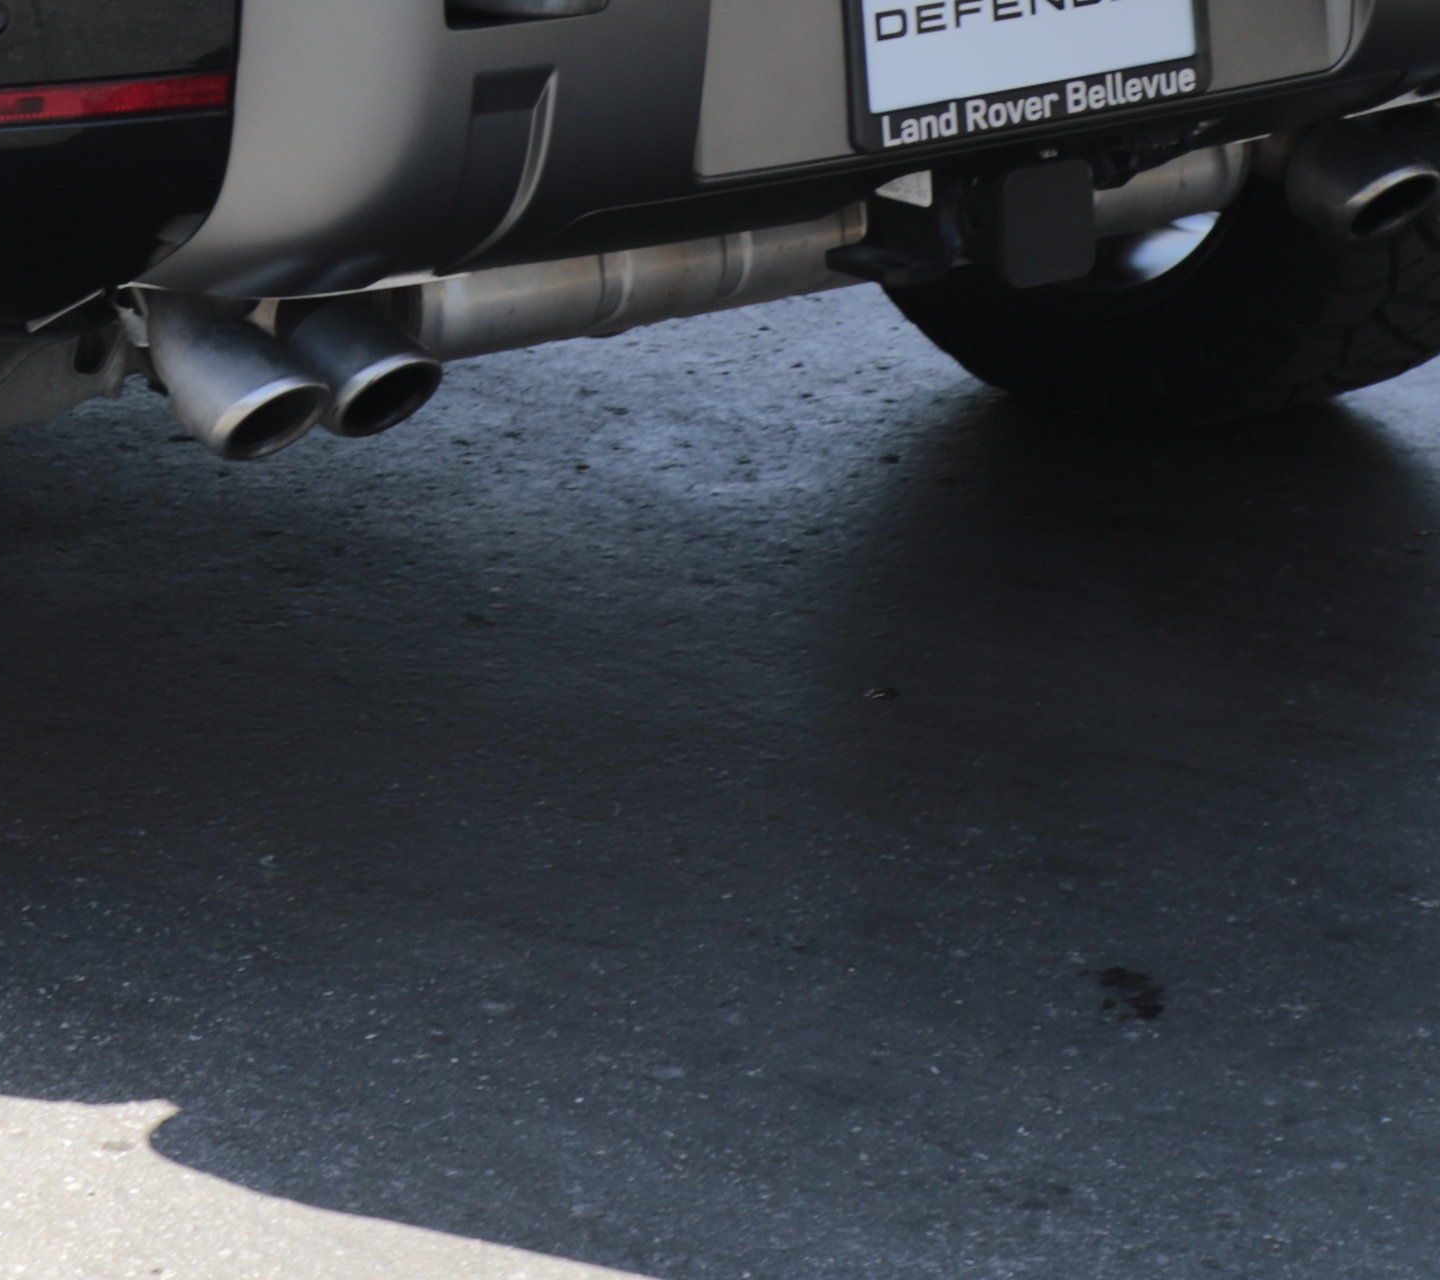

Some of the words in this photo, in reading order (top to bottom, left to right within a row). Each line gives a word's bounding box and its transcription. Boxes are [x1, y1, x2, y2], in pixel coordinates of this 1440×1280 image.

[881, 99, 960, 149] Land
[965, 91, 1060, 134] Rover
[1065, 66, 1197, 115] Bellevue
